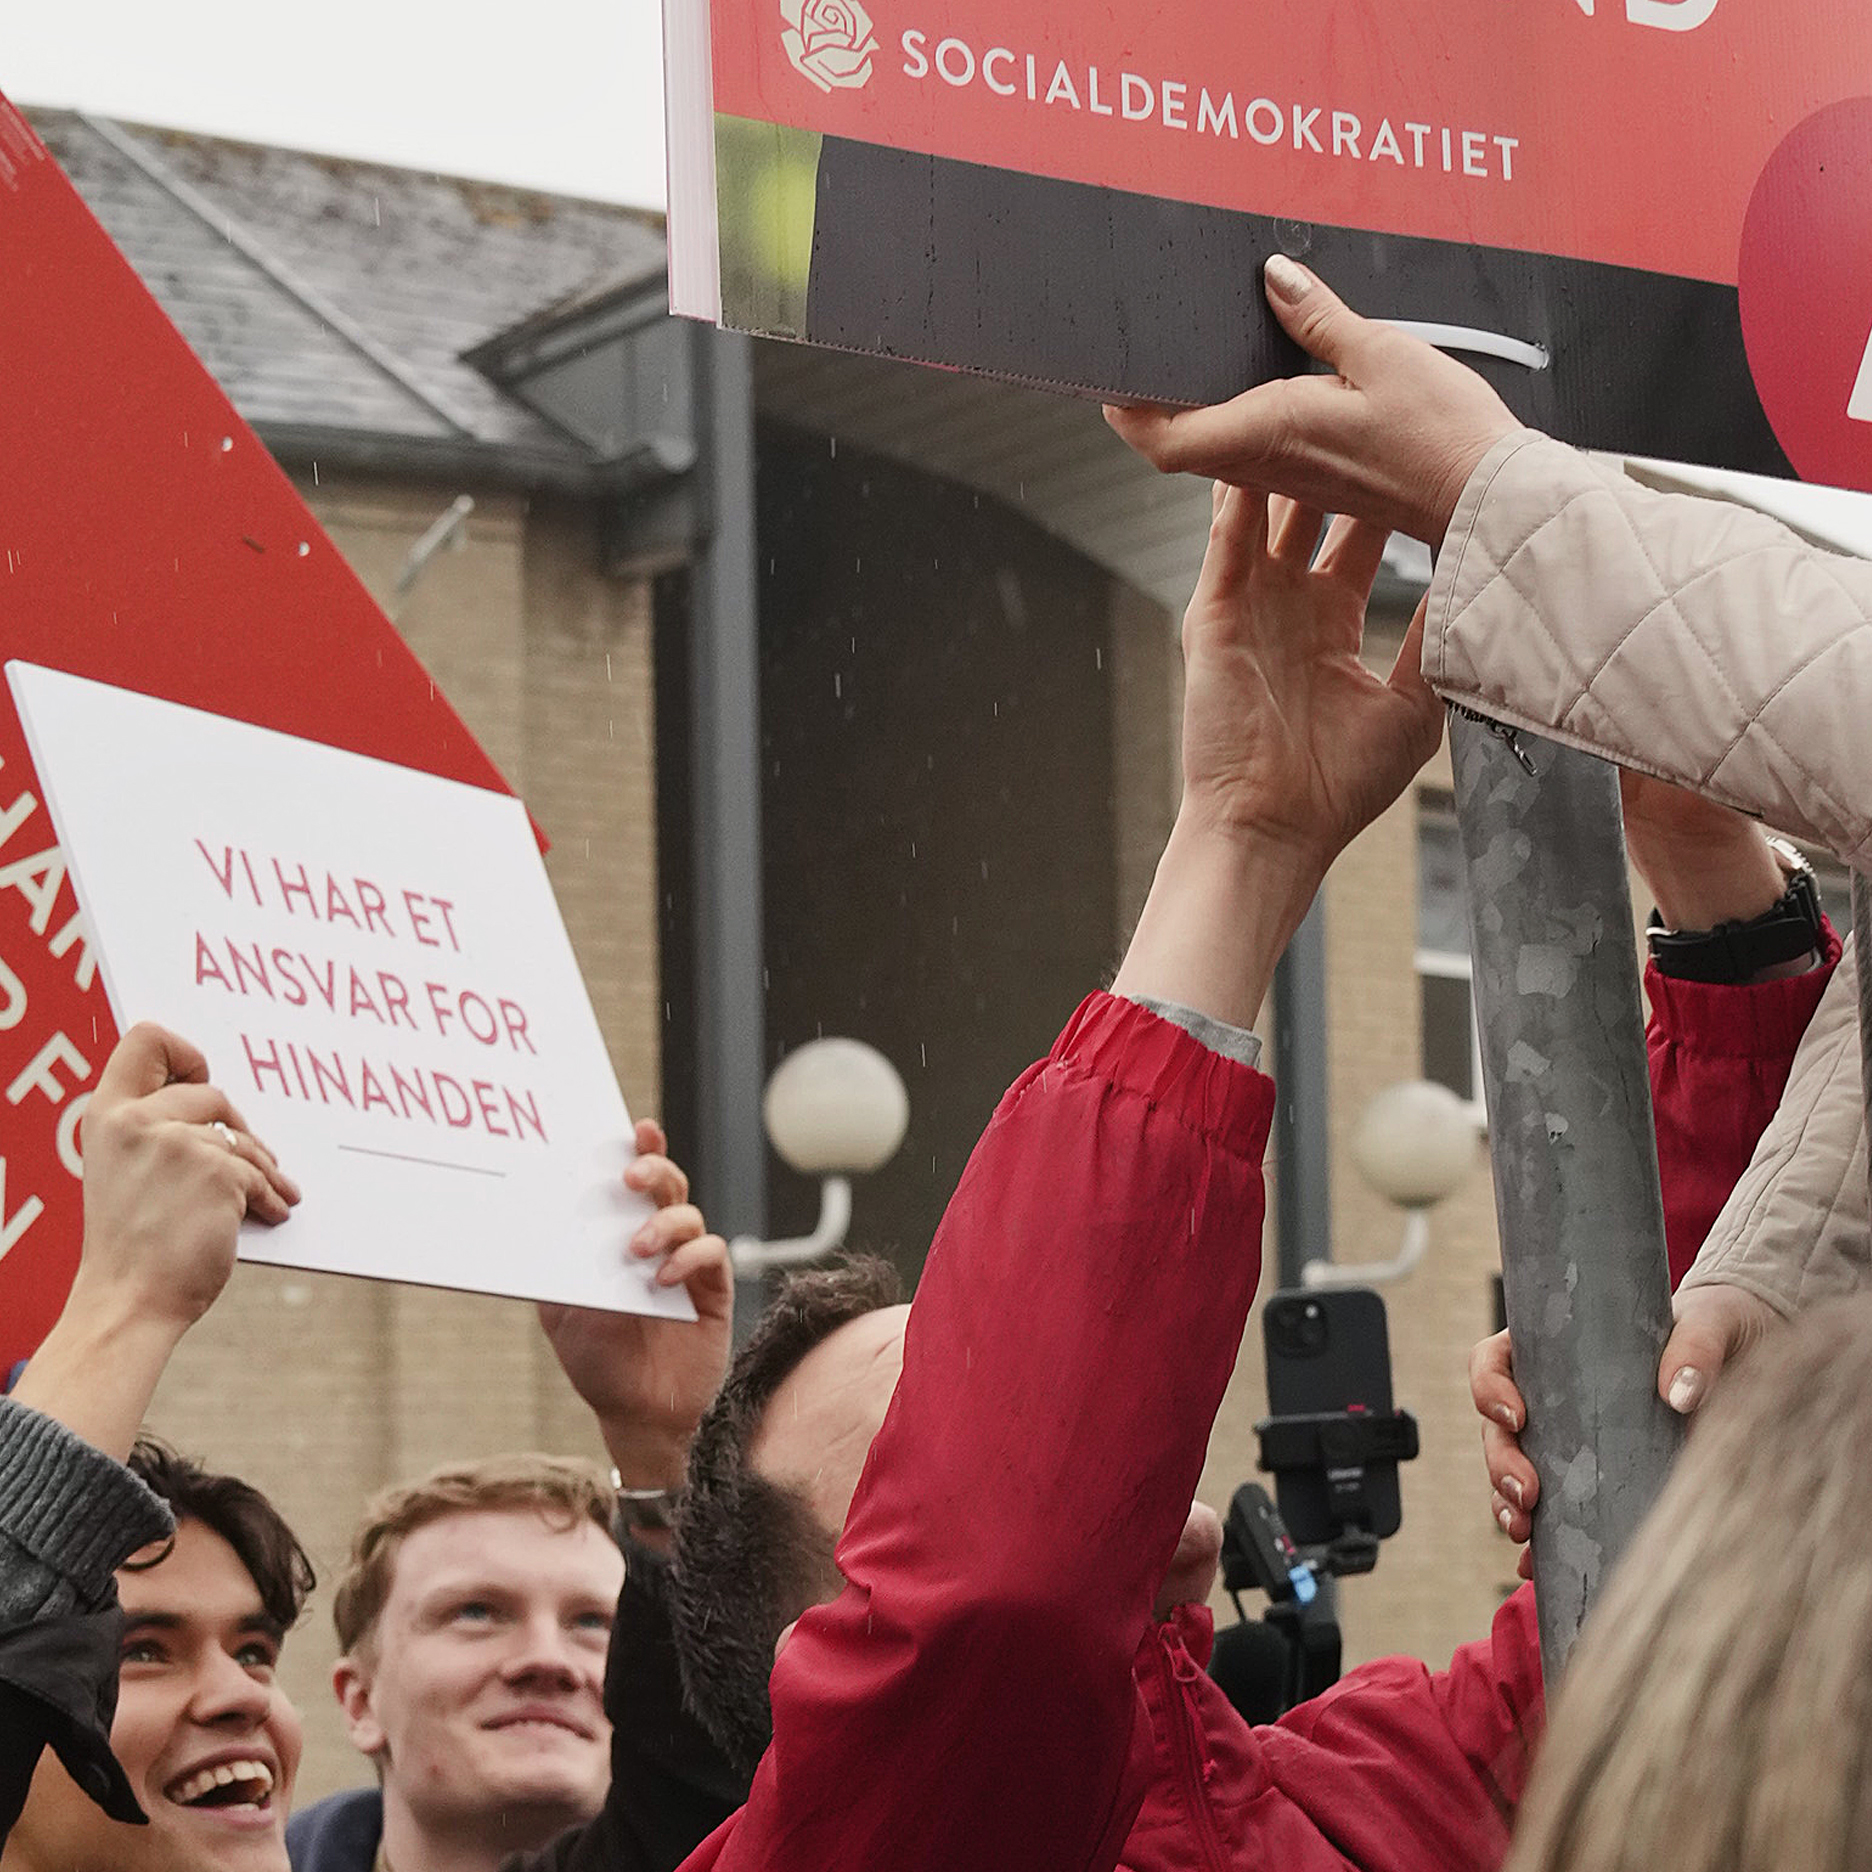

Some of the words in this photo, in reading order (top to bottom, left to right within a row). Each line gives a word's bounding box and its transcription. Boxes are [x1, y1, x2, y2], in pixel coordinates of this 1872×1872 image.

[901, 28, 1521, 182] SOCIALDEMOKRATIET
[194, 837, 263, 907] VI
[273, 856, 395, 939] HAR
[402, 889, 463, 953] ET
[194, 930, 418, 1033] ANSVAR
[426, 981, 538, 1056] FOR
[240, 1032, 549, 1146] HINANDEN
